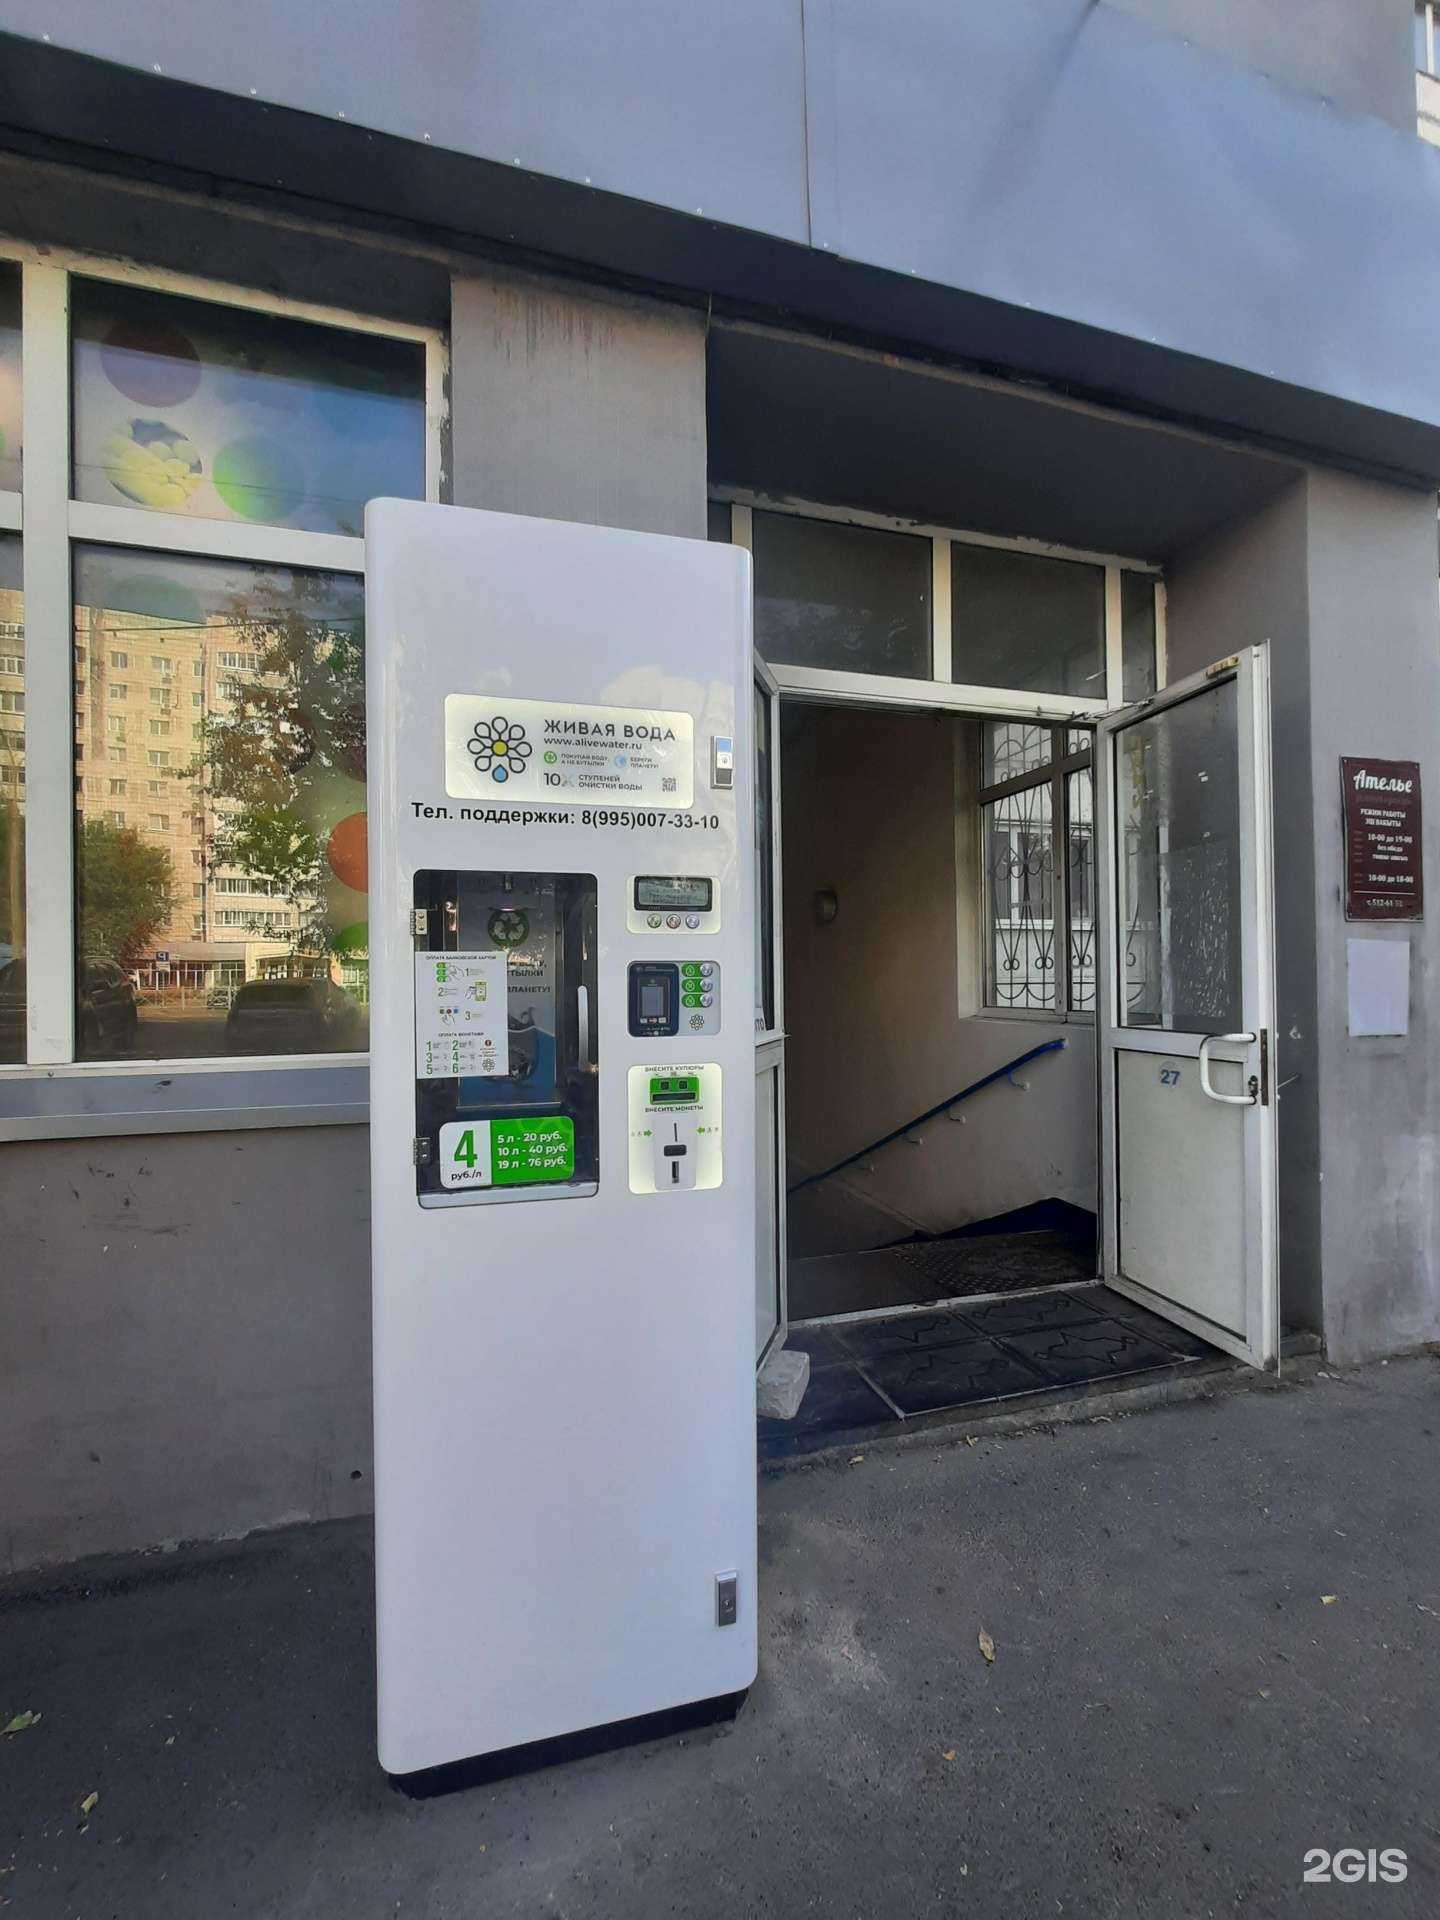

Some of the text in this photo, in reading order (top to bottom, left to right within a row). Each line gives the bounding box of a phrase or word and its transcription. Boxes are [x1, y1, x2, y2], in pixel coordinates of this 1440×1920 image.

[544, 719, 676, 742] ЖИВАЯ ВОДА
[544, 737, 643, 750] www.alivewater.ru
[578, 774, 620, 782] СТУПЕНЕЙ
[1353, 769, 1413, 793] Ателье
[578, 781, 643, 791] ОЧИСТКИ ВОДЫ
[411, 802, 719, 830] Тел. поддержки: 8(995)007-33-10
[507, 969, 544, 977] ТЫЛКИ
[426, 1041, 432, 1051] 1
[452, 1040, 459, 1051] 2
[426, 1052, 433, 1063] 3
[452, 1052, 459, 1063] 4
[426, 1064, 433, 1075] 5
[452, 1063, 459, 1074] 6
[1160, 1069, 1180, 1085] 27
[497, 1134, 504, 1144] 5
[523, 1132, 537, 1142] 20
[540, 1131, 562, 1143] руб.
[453, 1130, 478, 1168] 4
[497, 1147, 509, 1156] 10
[528, 1144, 543, 1154] 40
[545, 1143, 568, 1156] руб.
[497, 1160, 508, 1169] 19
[528, 1157, 542, 1167] 76
[544, 1156, 566, 1169] руб.
[451, 1170, 482, 1180] руб./л
